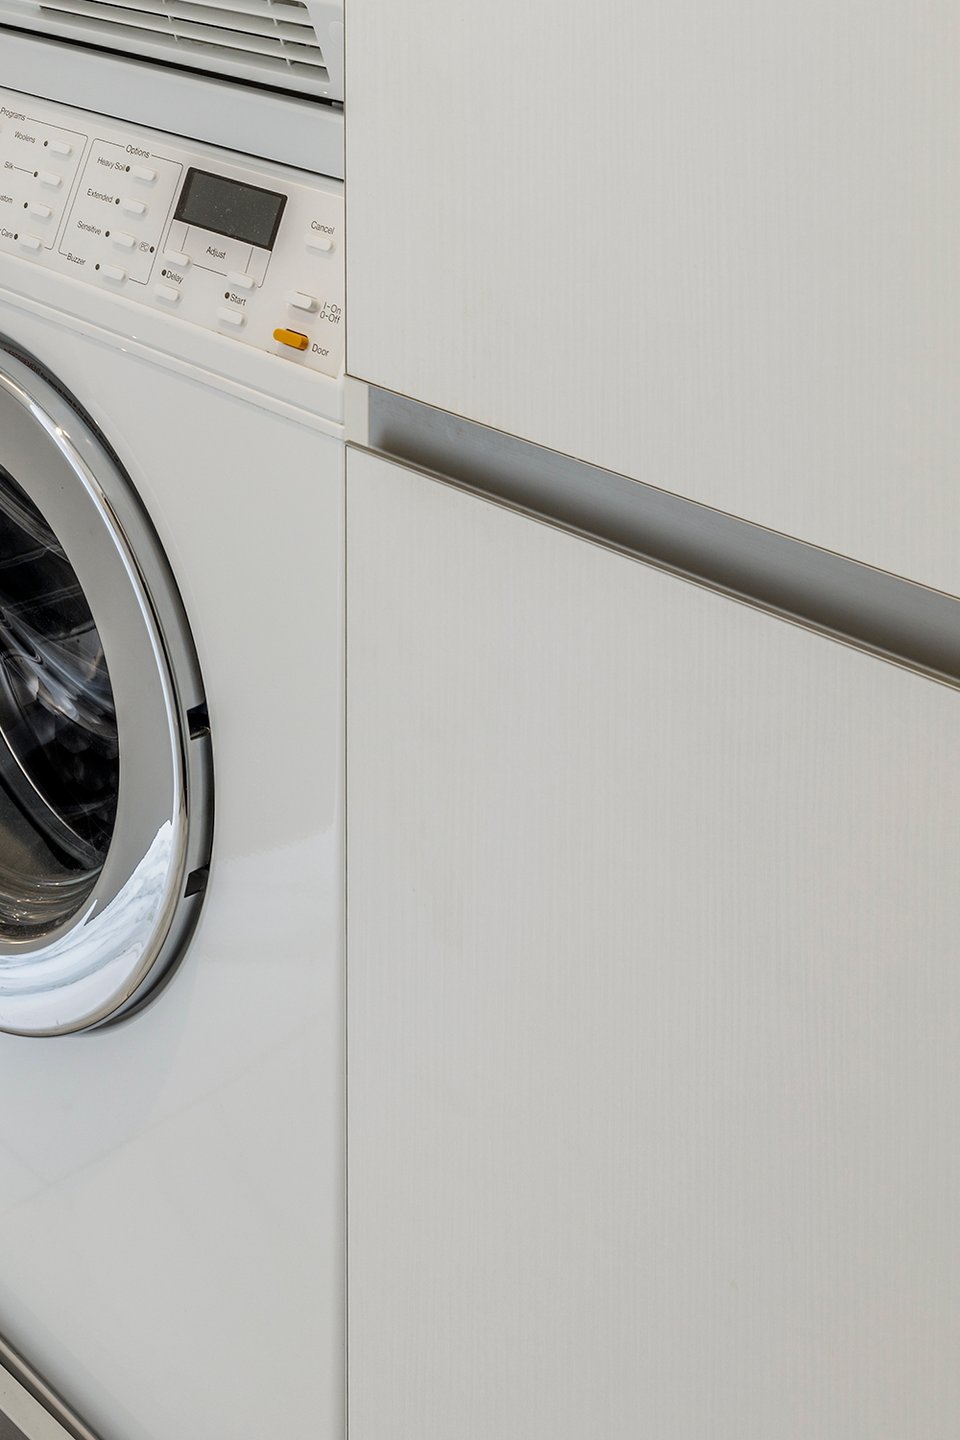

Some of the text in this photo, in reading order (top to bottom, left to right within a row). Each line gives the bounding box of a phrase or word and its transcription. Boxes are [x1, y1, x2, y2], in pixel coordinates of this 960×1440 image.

[0, 107, 26, 121] Programs
[14, 131, 36, 144] Woolens
[126, 144, 150, 159] Options
[97, 157, 126, 172] Heavy Soil
[87, 188, 113, 203] Extended
[1, 228, 14, 239] Care
[77, 220, 101, 236] Sensitive
[311, 220, 335, 235] Cancel
[66, 252, 86, 266] Buzzer
[206, 246, 226, 259] Adjust
[167, 270, 183, 284] Delay
[230, 293, 246, 306] Start
[312, 343, 329, 357] Door
